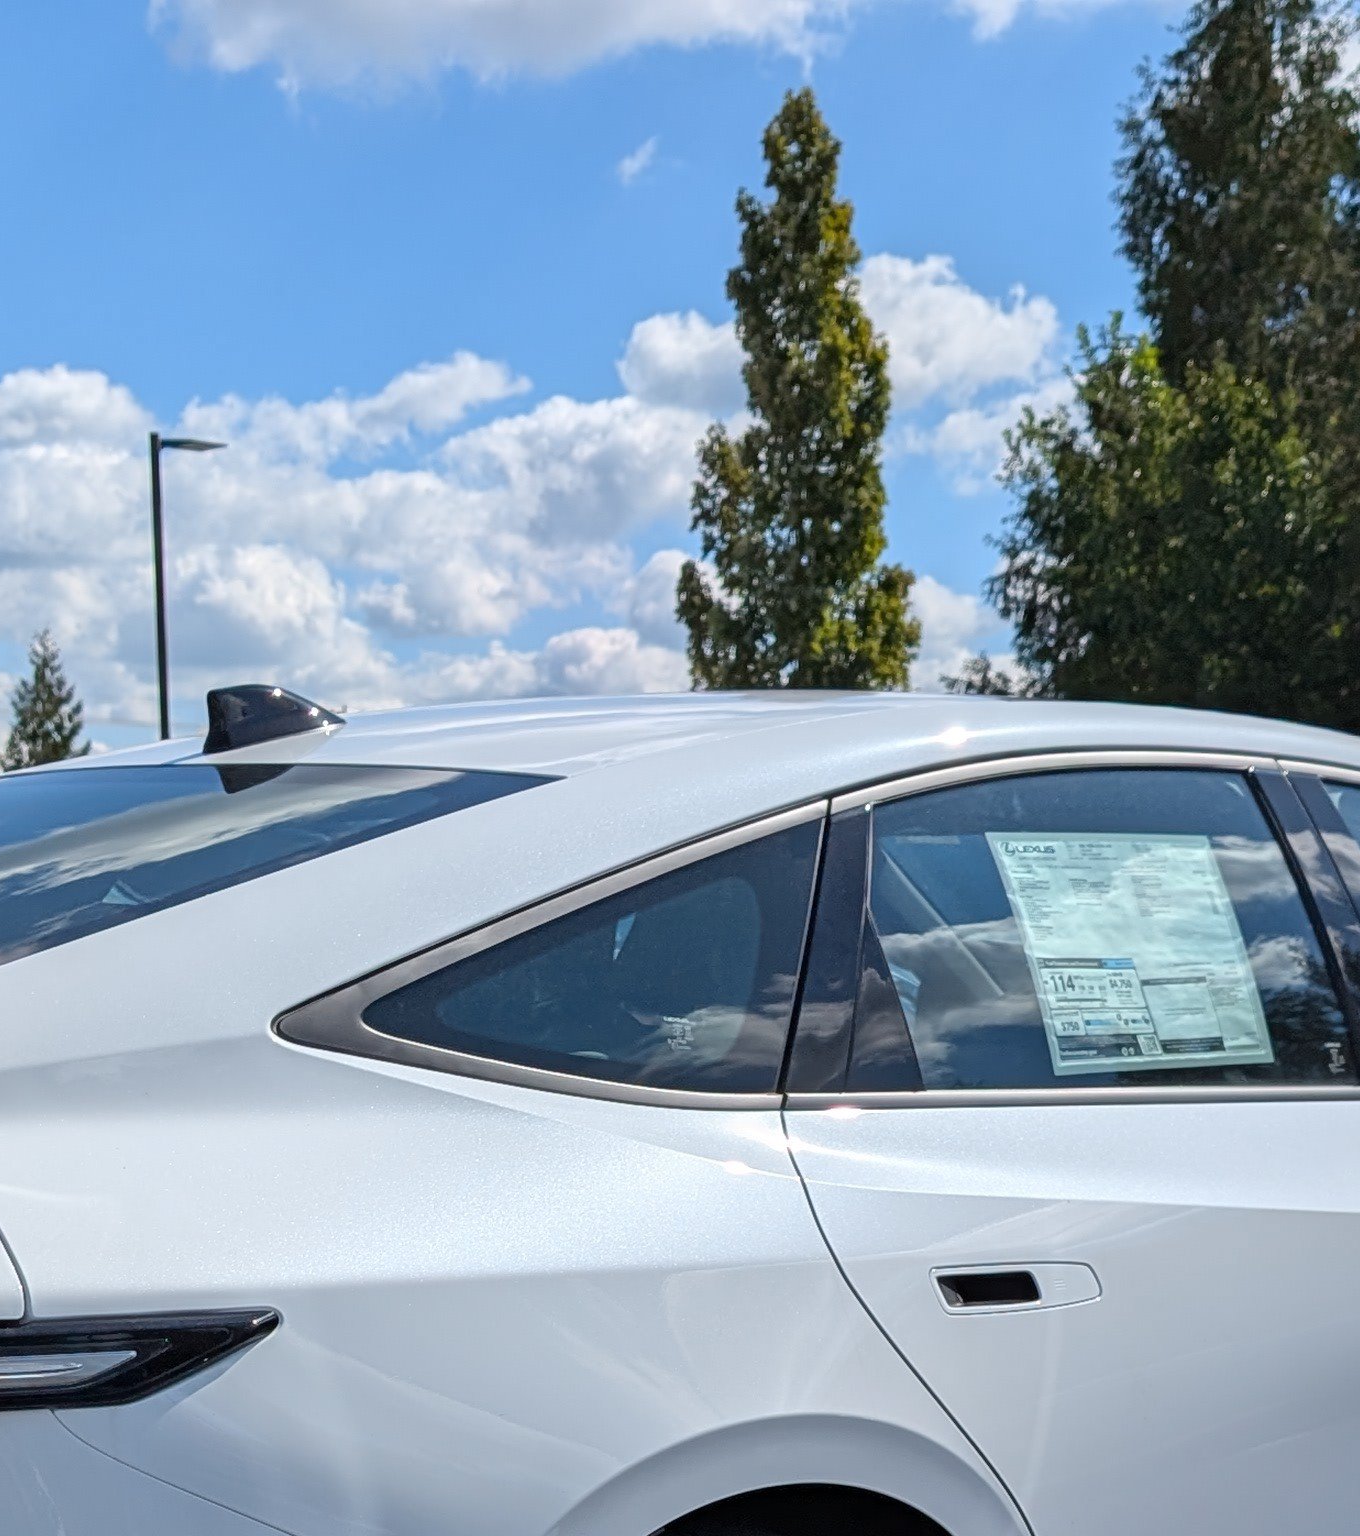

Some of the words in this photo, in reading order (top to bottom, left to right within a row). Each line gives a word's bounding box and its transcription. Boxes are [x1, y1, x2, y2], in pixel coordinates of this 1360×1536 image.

[1016, 845, 1056, 854] LEXUS
[1050, 974, 1076, 992] 114
[1061, 1021, 1080, 1032] $750
